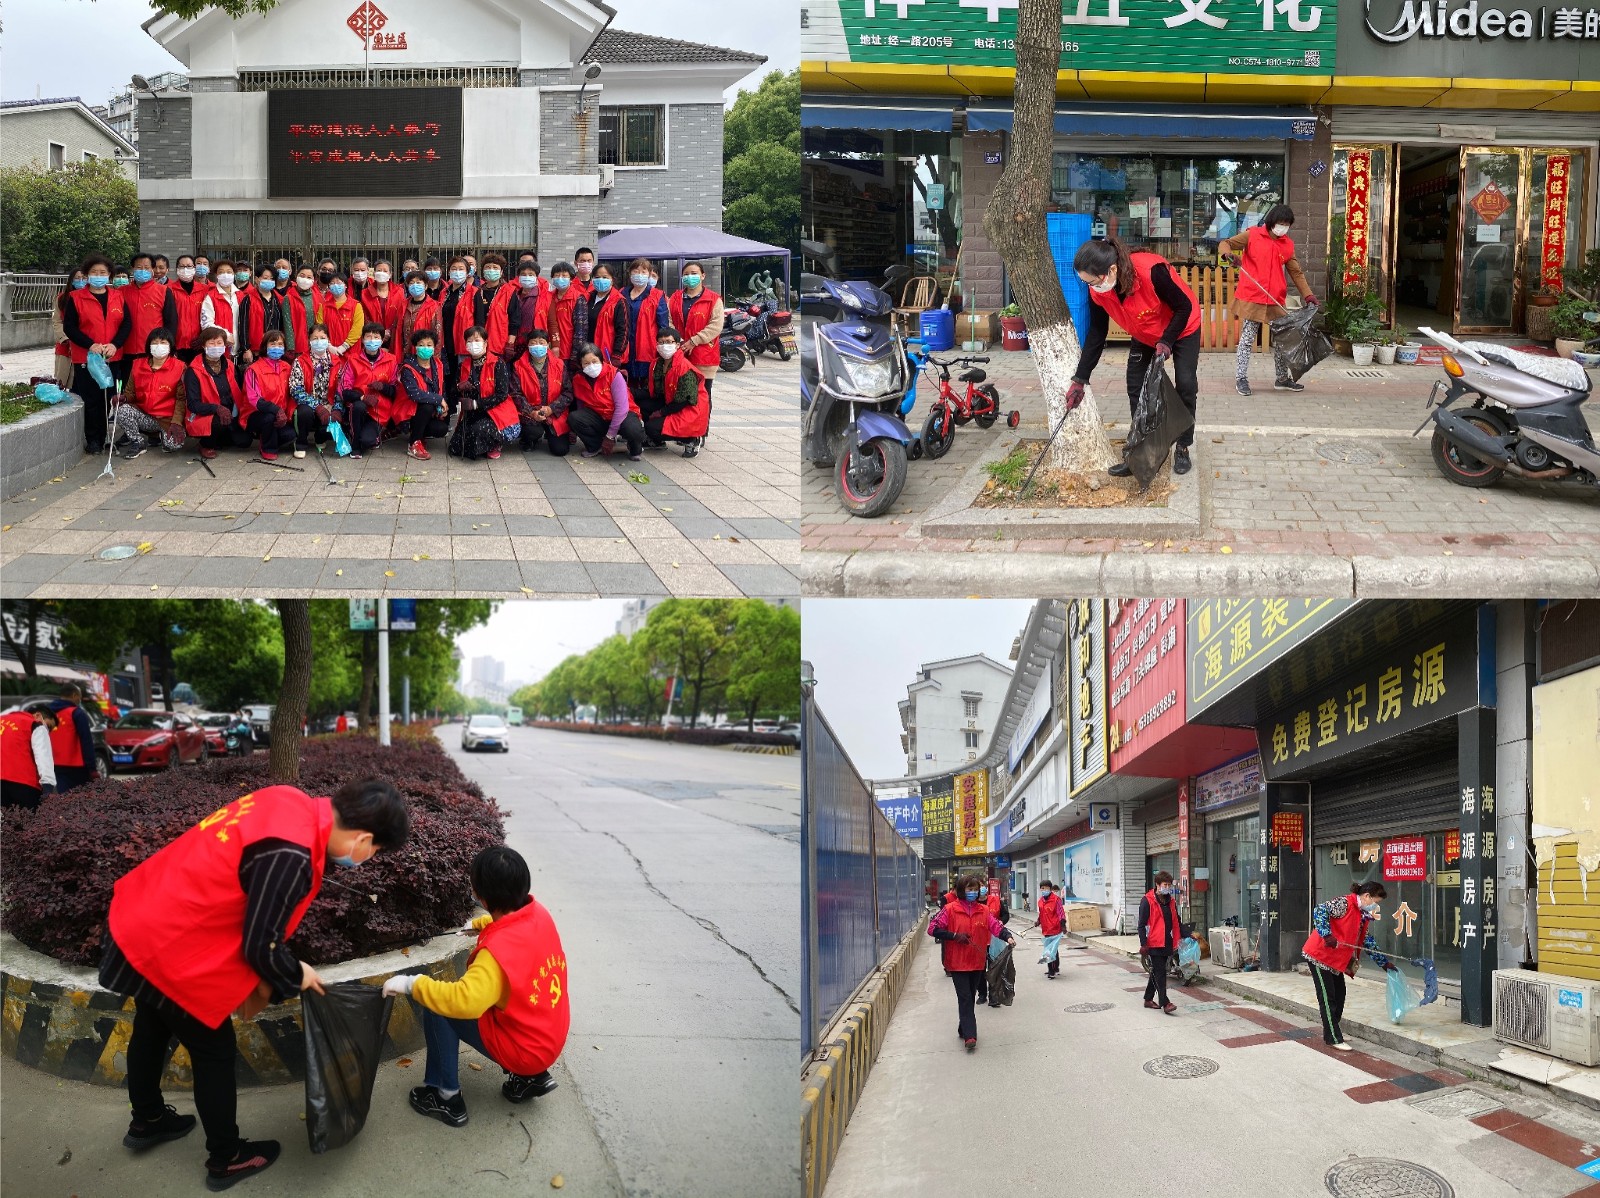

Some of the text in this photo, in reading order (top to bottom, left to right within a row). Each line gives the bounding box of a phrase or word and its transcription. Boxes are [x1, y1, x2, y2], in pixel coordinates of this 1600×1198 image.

[1366, 0, 1533, 42] Midea
[1007, 330, 1028, 340] Mob
[1203, 599, 1311, 687] 海源装
[1272, 642, 1446, 765] 免费登记房源
[1386, 841, 1423, 854] 店面便宜出租
[1391, 854, 1417, 866] 无转让费
[1462, 786, 1477, 949] 海源房产
[1482, 785, 1495, 950] 海源房产
